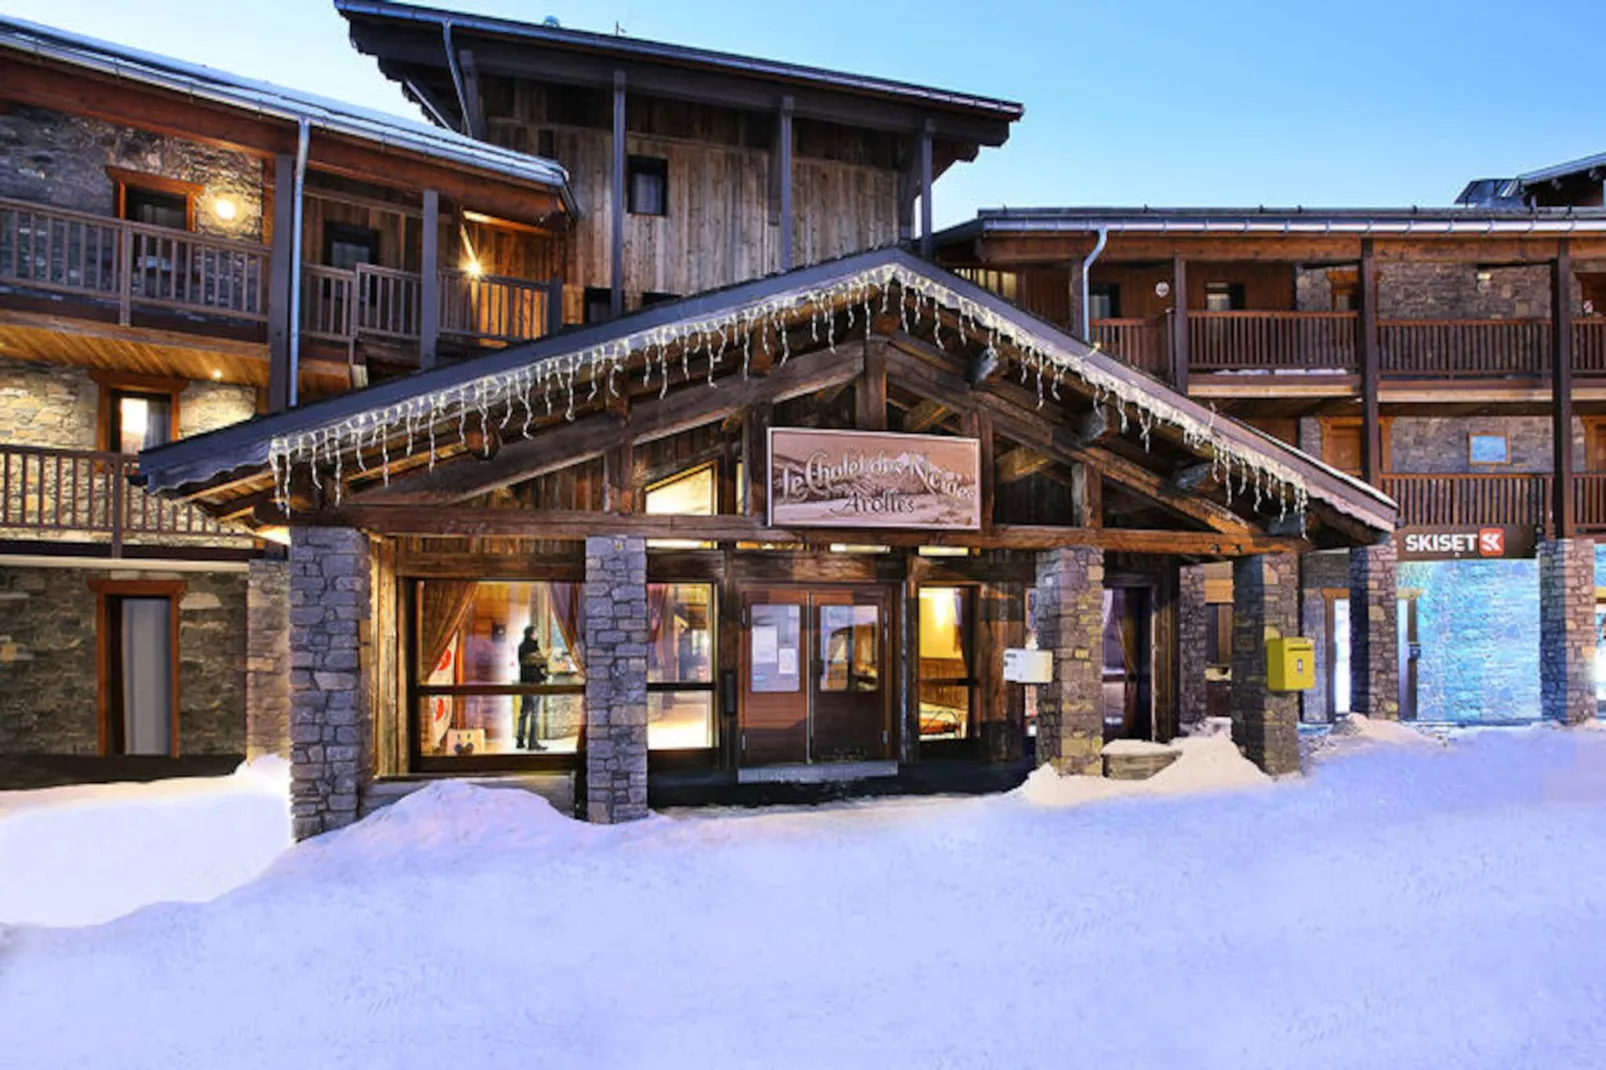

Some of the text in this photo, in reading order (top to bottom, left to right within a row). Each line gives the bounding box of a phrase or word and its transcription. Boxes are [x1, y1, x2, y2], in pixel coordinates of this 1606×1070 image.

[781, 466, 808, 502] Le
[805, 451, 865, 497] Chalet
[870, 450, 903, 475] des
[830, 491, 915, 514] Arolles
[1405, 533, 1478, 552] SKISET
